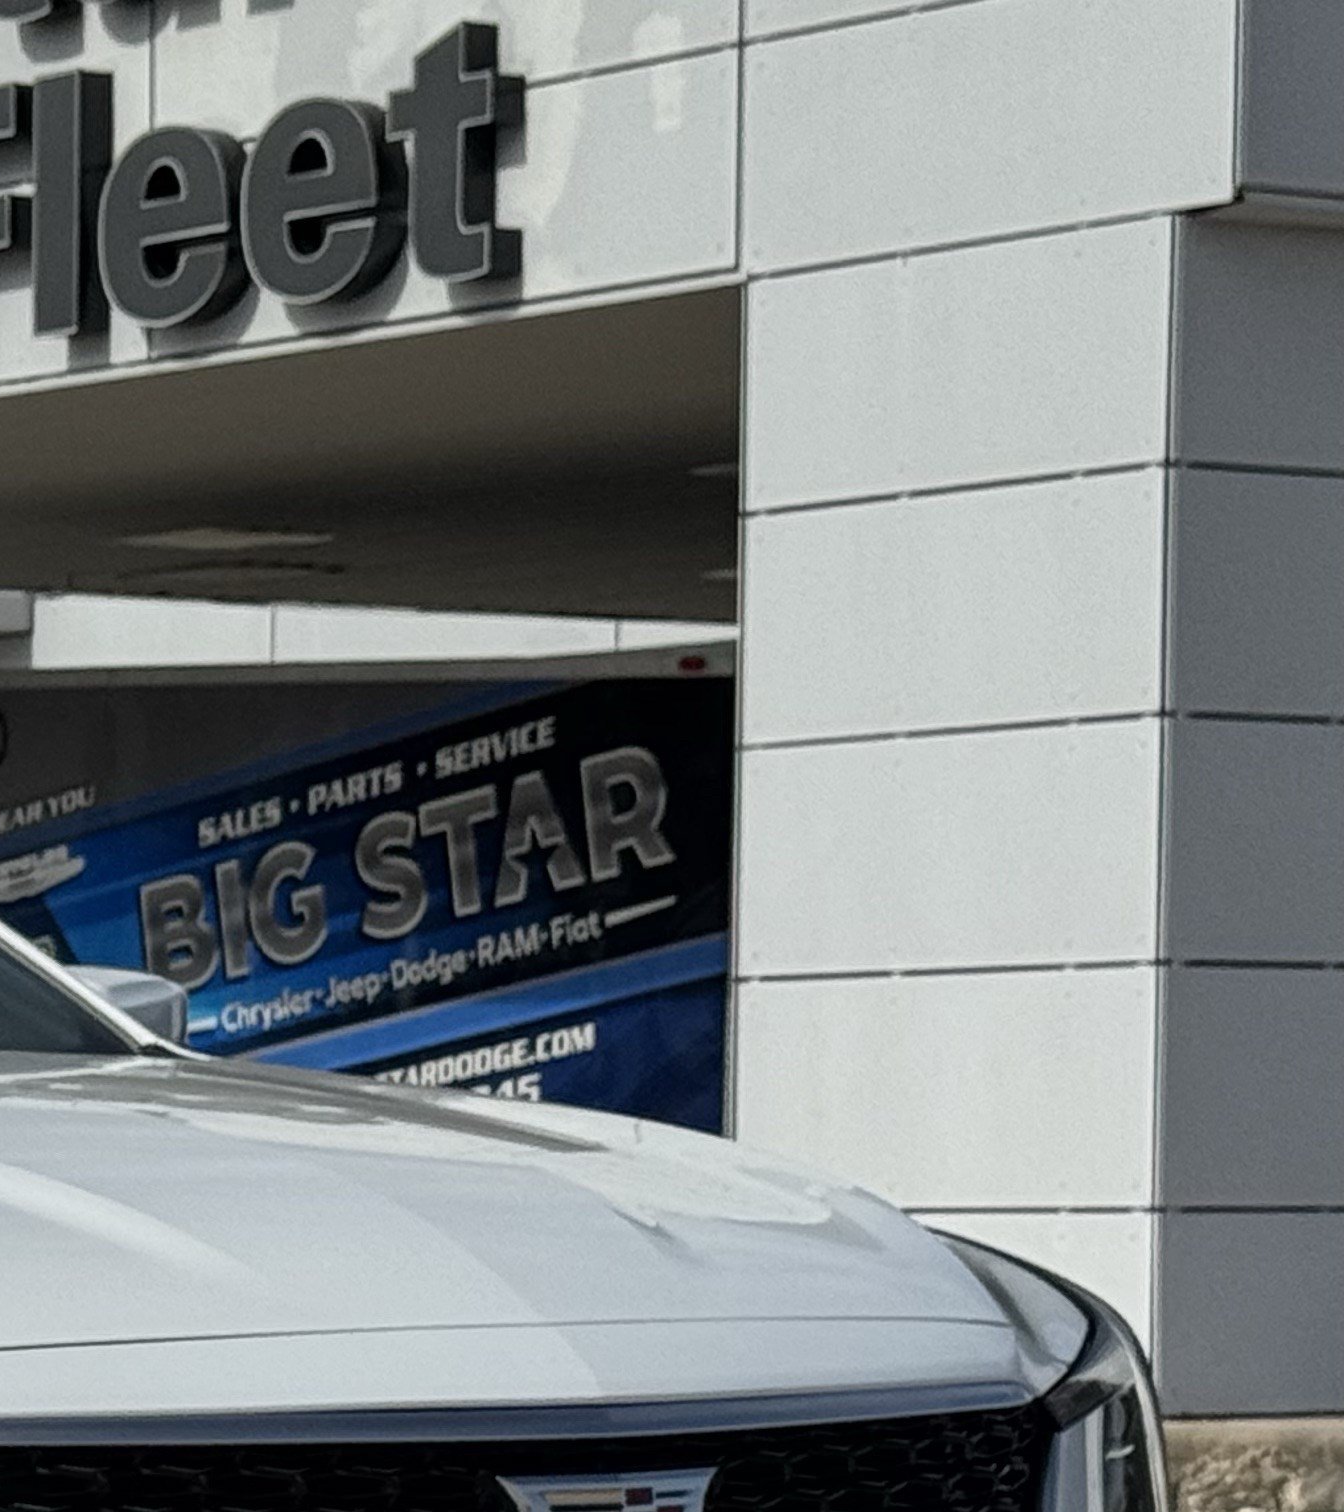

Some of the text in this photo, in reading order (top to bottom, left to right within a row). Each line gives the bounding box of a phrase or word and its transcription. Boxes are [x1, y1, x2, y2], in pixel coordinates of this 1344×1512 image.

[47, 785, 96, 815] YOU
[197, 715, 559, 849] SALES PARTS SERVICE
[139, 746, 677, 991] BIG STAR
